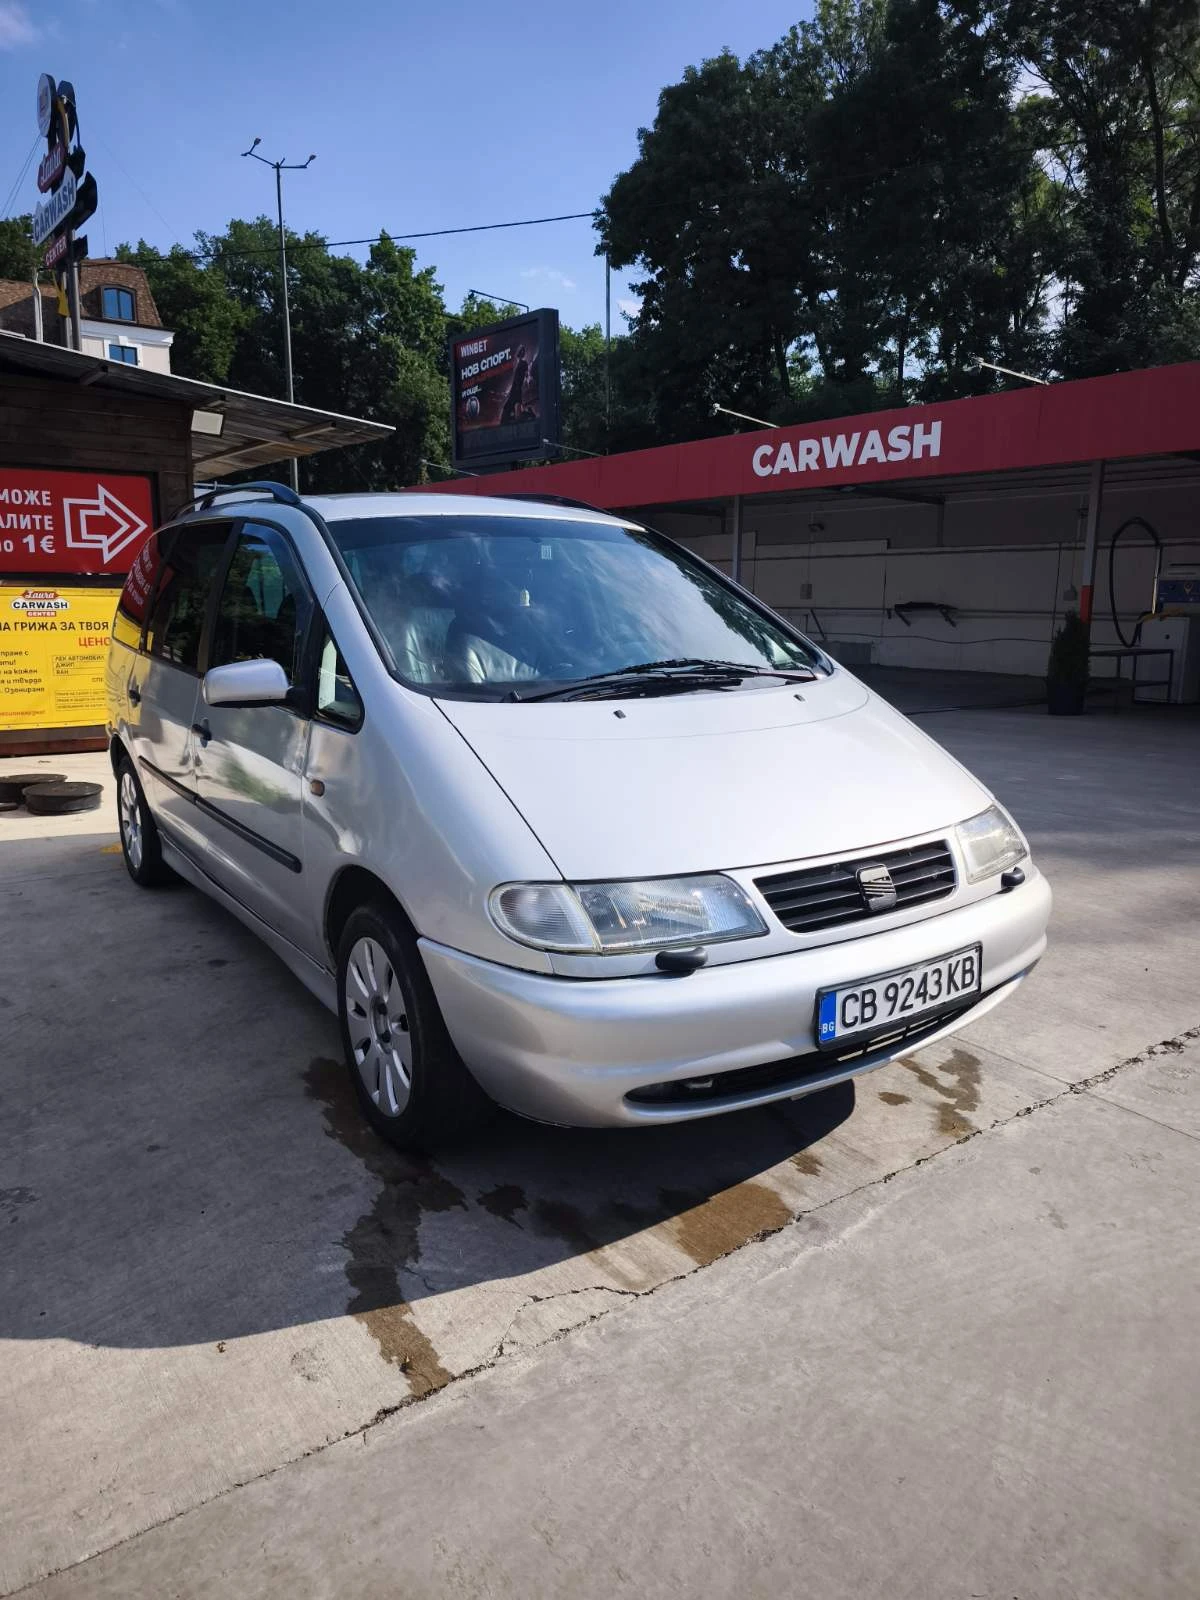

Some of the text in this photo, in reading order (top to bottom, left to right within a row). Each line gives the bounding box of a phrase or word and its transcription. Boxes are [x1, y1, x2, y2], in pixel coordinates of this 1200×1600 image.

[34, 178, 75, 242] CARWASH
[45, 238, 67, 266] CENTER
[460, 339, 488, 358] WINBET
[461, 363, 480, 381] НОВ
[480, 348, 512, 372] СПОРТ.
[752, 421, 942, 477] CARWASH
[22, 534, 56, 554] 1€
[13, 601, 68, 609] CARWASH
[0, 621, 109, 631] А ГРИЖА ЗА ТВОЯ
[841, 955, 975, 1028] CB 9243 KB
[822, 1021, 834, 1034] BG
